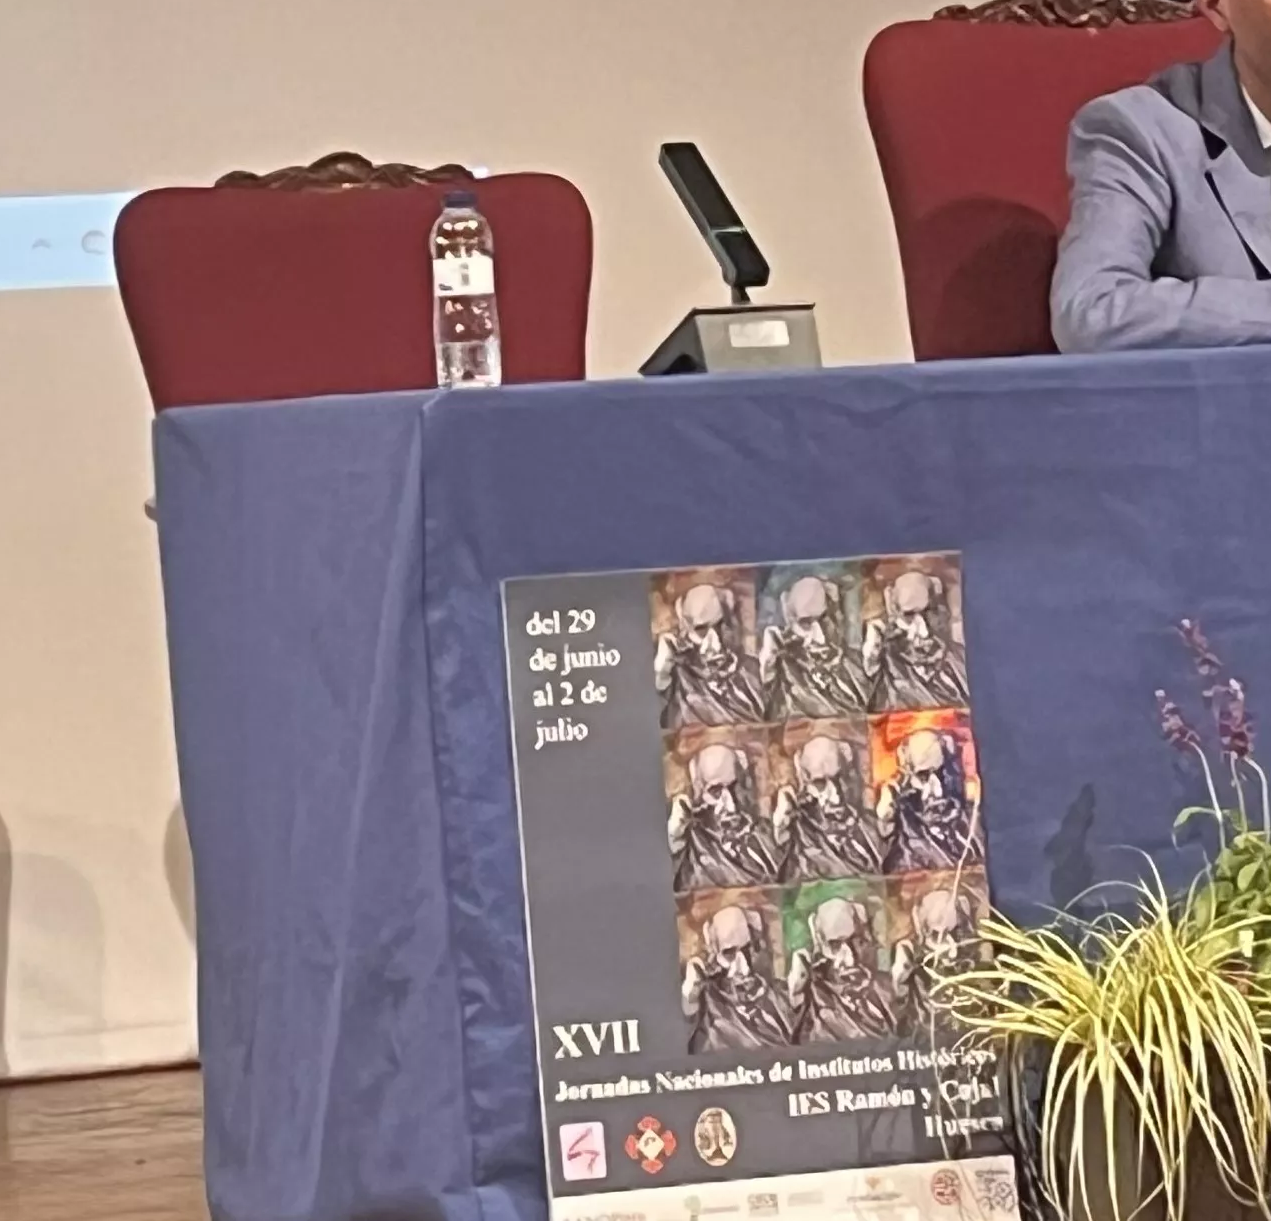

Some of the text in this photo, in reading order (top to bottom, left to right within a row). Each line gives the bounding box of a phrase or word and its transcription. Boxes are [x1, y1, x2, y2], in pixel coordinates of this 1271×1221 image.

[526, 609, 596, 636] del 29
[529, 642, 621, 676] de junio
[533, 679, 607, 707] al 2 de
[534, 717, 589, 750] julio
[553, 1019, 640, 1059] XVII
[555, 1076, 651, 1102] Jornadas
[655, 1065, 764, 1094] Nacionales
[769, 1062, 792, 1082] de
[798, 1055, 893, 1079] Institutos
[788, 1091, 830, 1117] IES
[835, 1083, 916, 1112] Ramón
[920, 1087, 931, 1109] y
